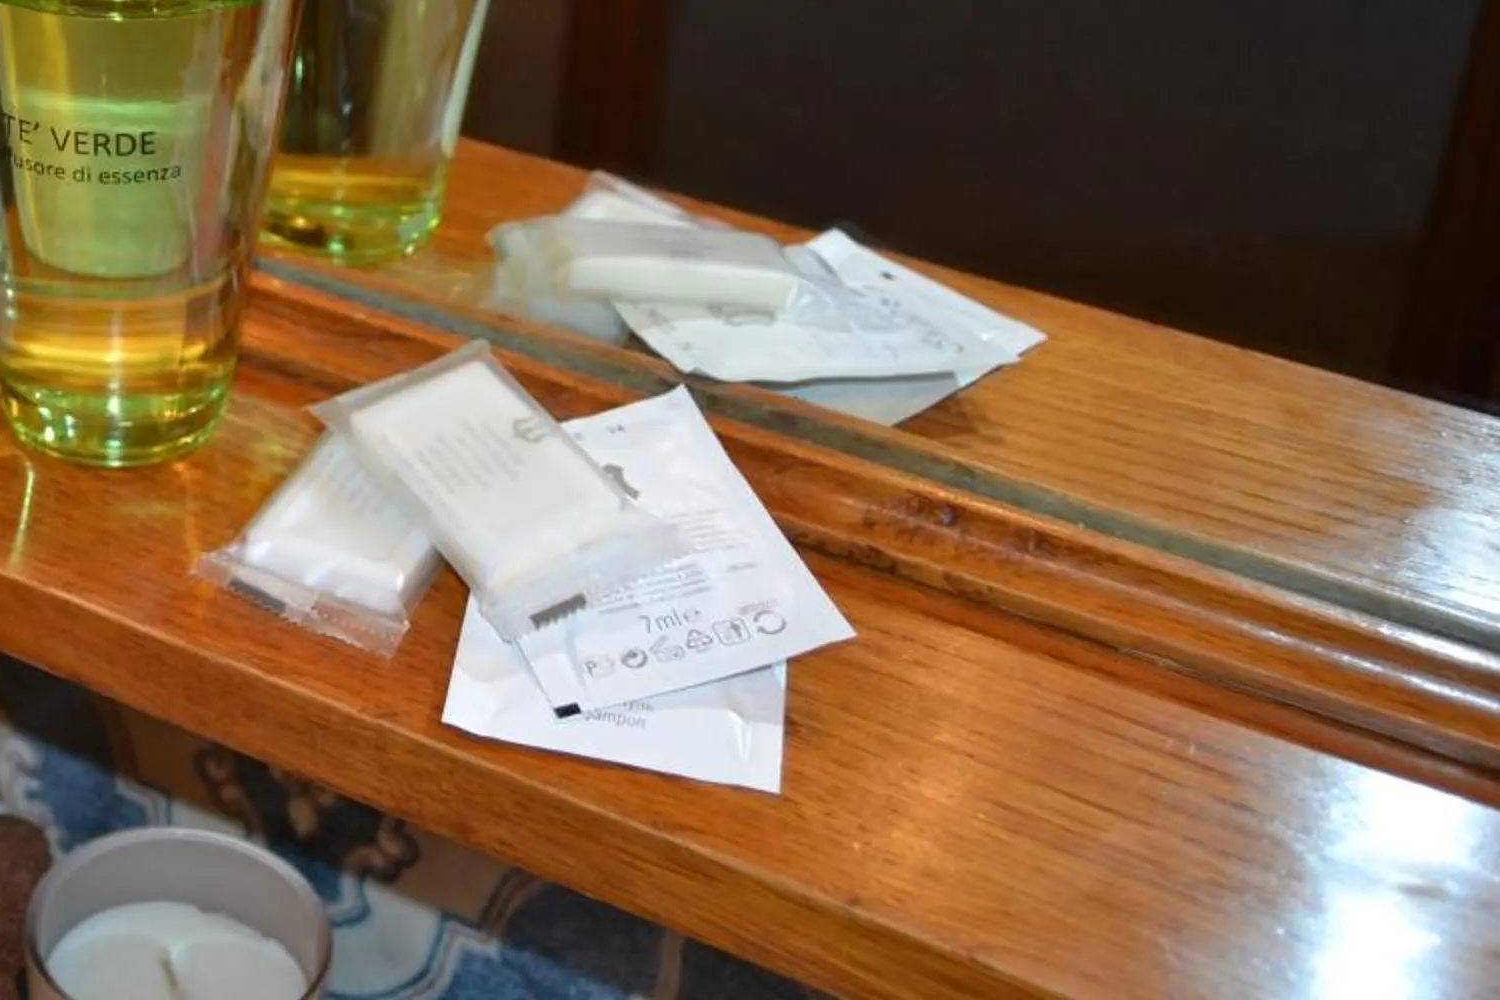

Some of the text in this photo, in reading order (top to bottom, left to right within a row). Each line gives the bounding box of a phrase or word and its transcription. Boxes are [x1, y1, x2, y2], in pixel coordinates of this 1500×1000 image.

[49, 125, 157, 157] VERDE
[72, 165, 92, 183] di
[99, 164, 181, 185] essenza
